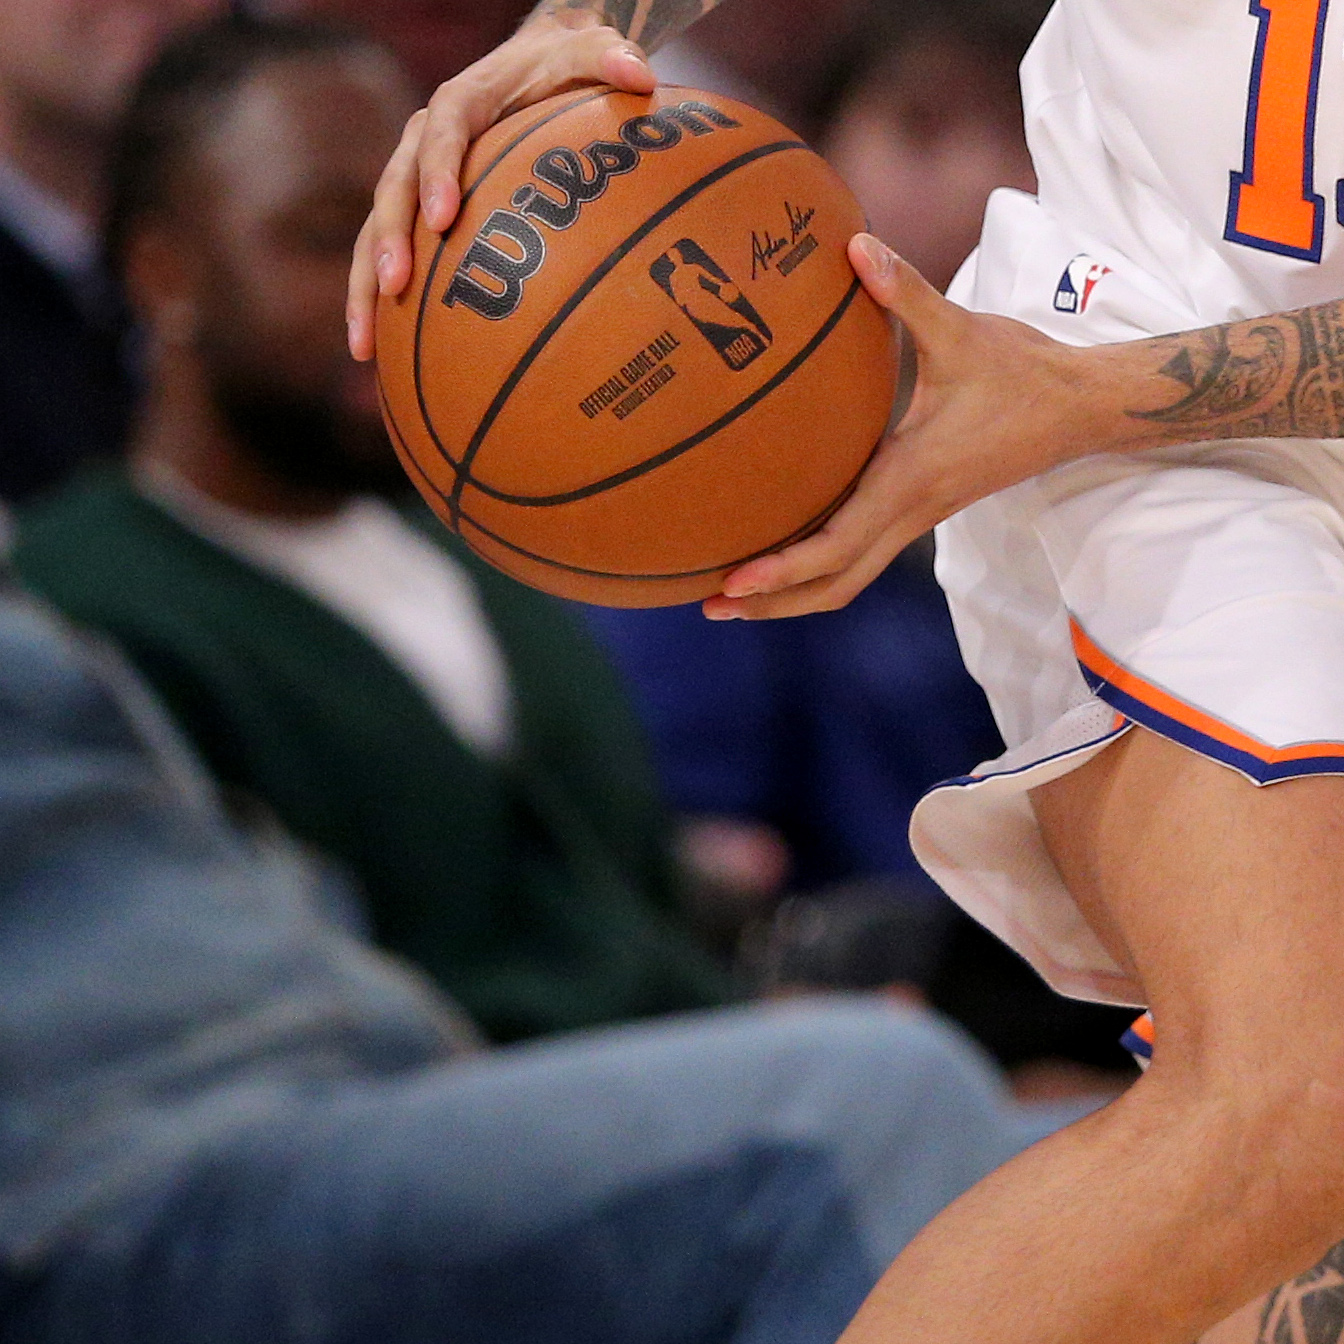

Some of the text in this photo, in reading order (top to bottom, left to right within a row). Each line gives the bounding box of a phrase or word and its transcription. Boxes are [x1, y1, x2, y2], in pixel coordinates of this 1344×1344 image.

[440, 98, 743, 321] Wilson
[578, 329, 681, 419] OFFICIAL GAME BALL
[724, 332, 758, 367] NBA
